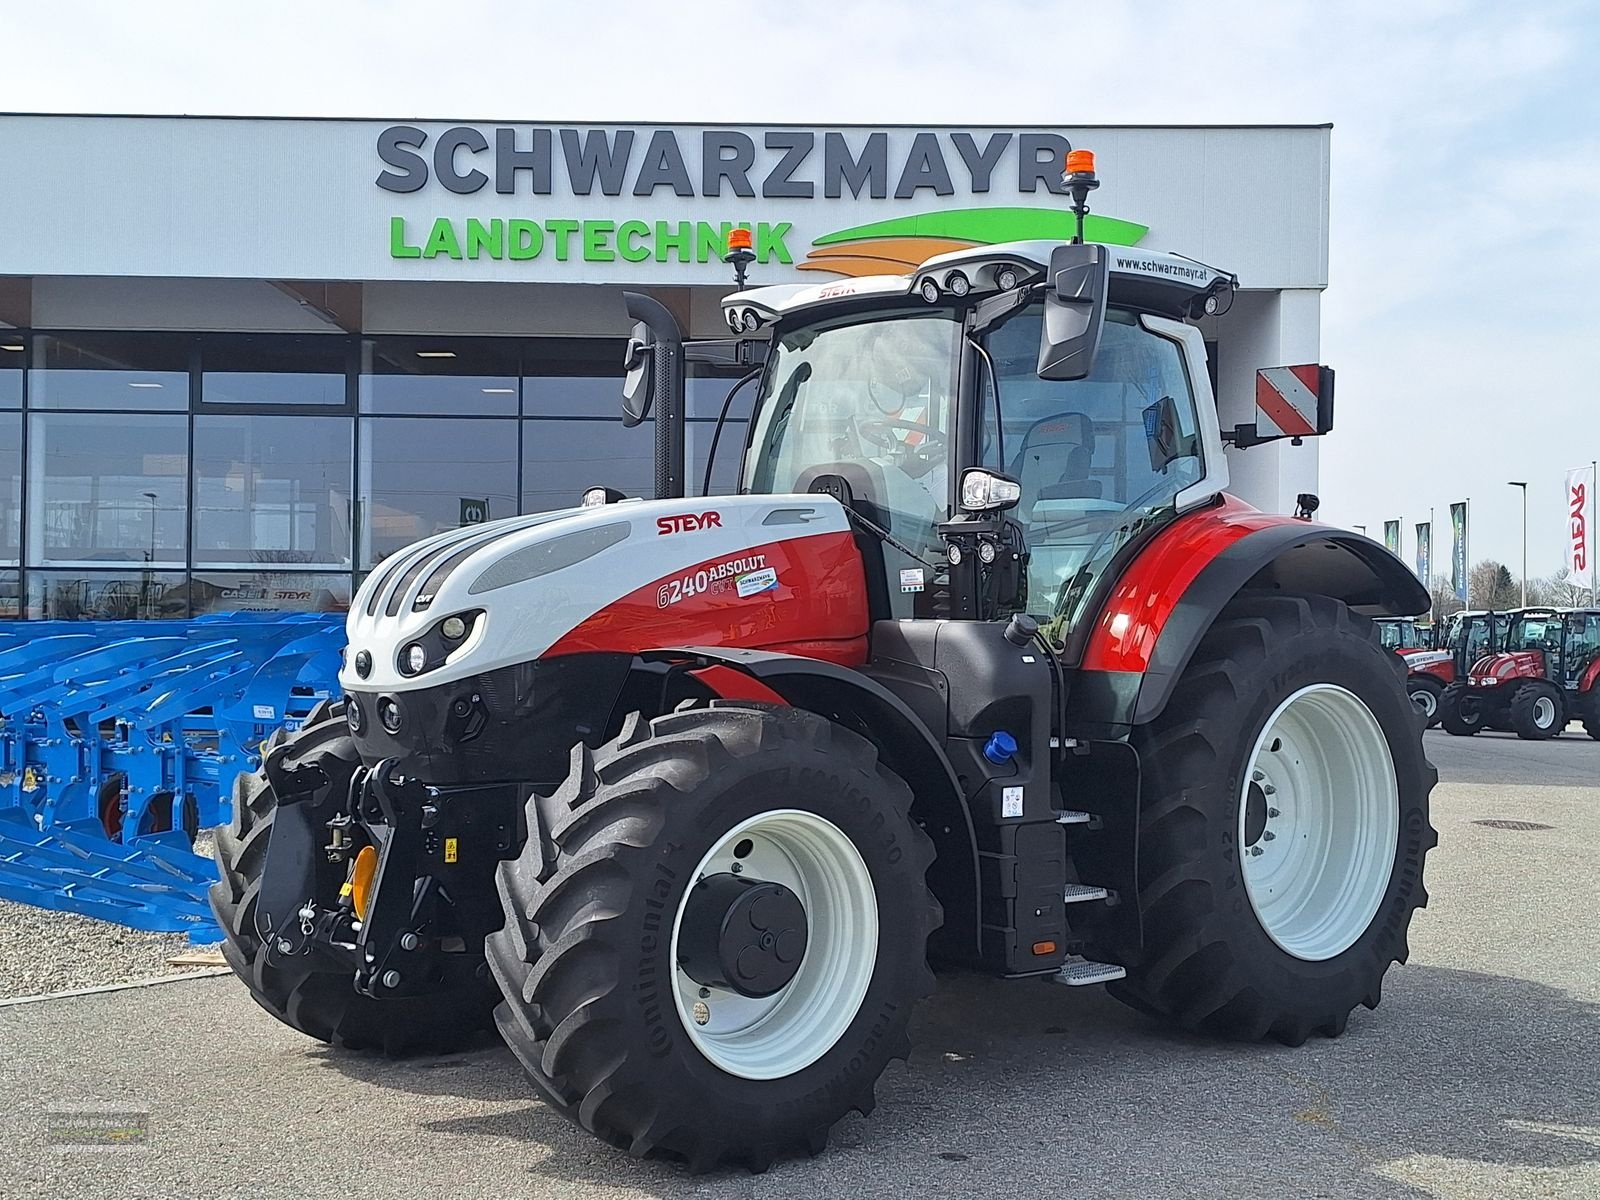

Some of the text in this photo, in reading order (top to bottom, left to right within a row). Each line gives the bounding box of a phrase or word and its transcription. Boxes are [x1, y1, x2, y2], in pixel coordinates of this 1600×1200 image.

[375, 125, 1072, 200] SCHWARZMAYR
[390, 216, 794, 265] LANDTECHNK
[1116, 258, 1208, 281] www.schwarzmayr.at
[656, 511, 723, 536] STEYR
[272, 590, 312, 601] STEYR
[656, 554, 766, 609] 6240 ABSOLUT
[710, 577, 734, 596] CVT
[634, 862, 677, 1059] Continental
